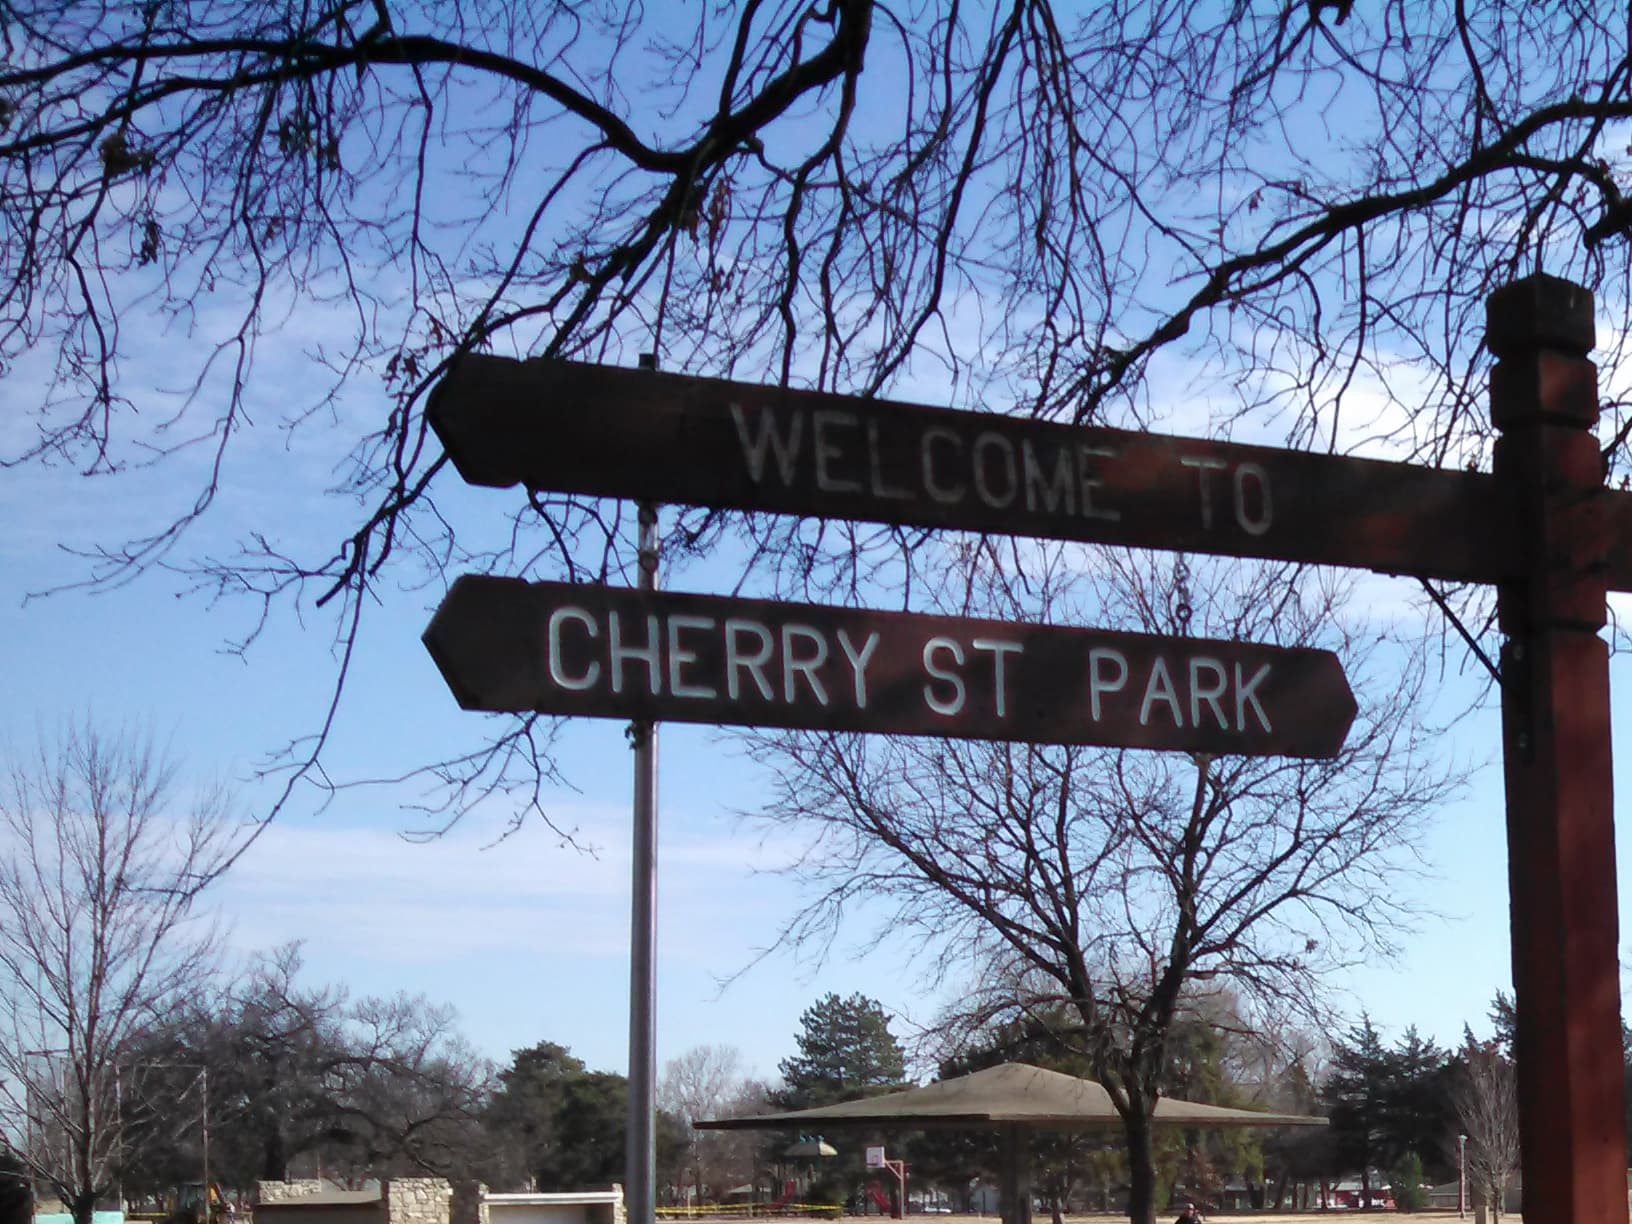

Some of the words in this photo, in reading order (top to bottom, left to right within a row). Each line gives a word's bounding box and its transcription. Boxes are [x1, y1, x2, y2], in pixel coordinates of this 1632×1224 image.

[731, 404, 1121, 521] WELCOME
[1180, 455, 1273, 535] TO
[546, 606, 882, 709] CHERRY
[921, 635, 1023, 719] ST
[1088, 648, 1275, 733] PARK
